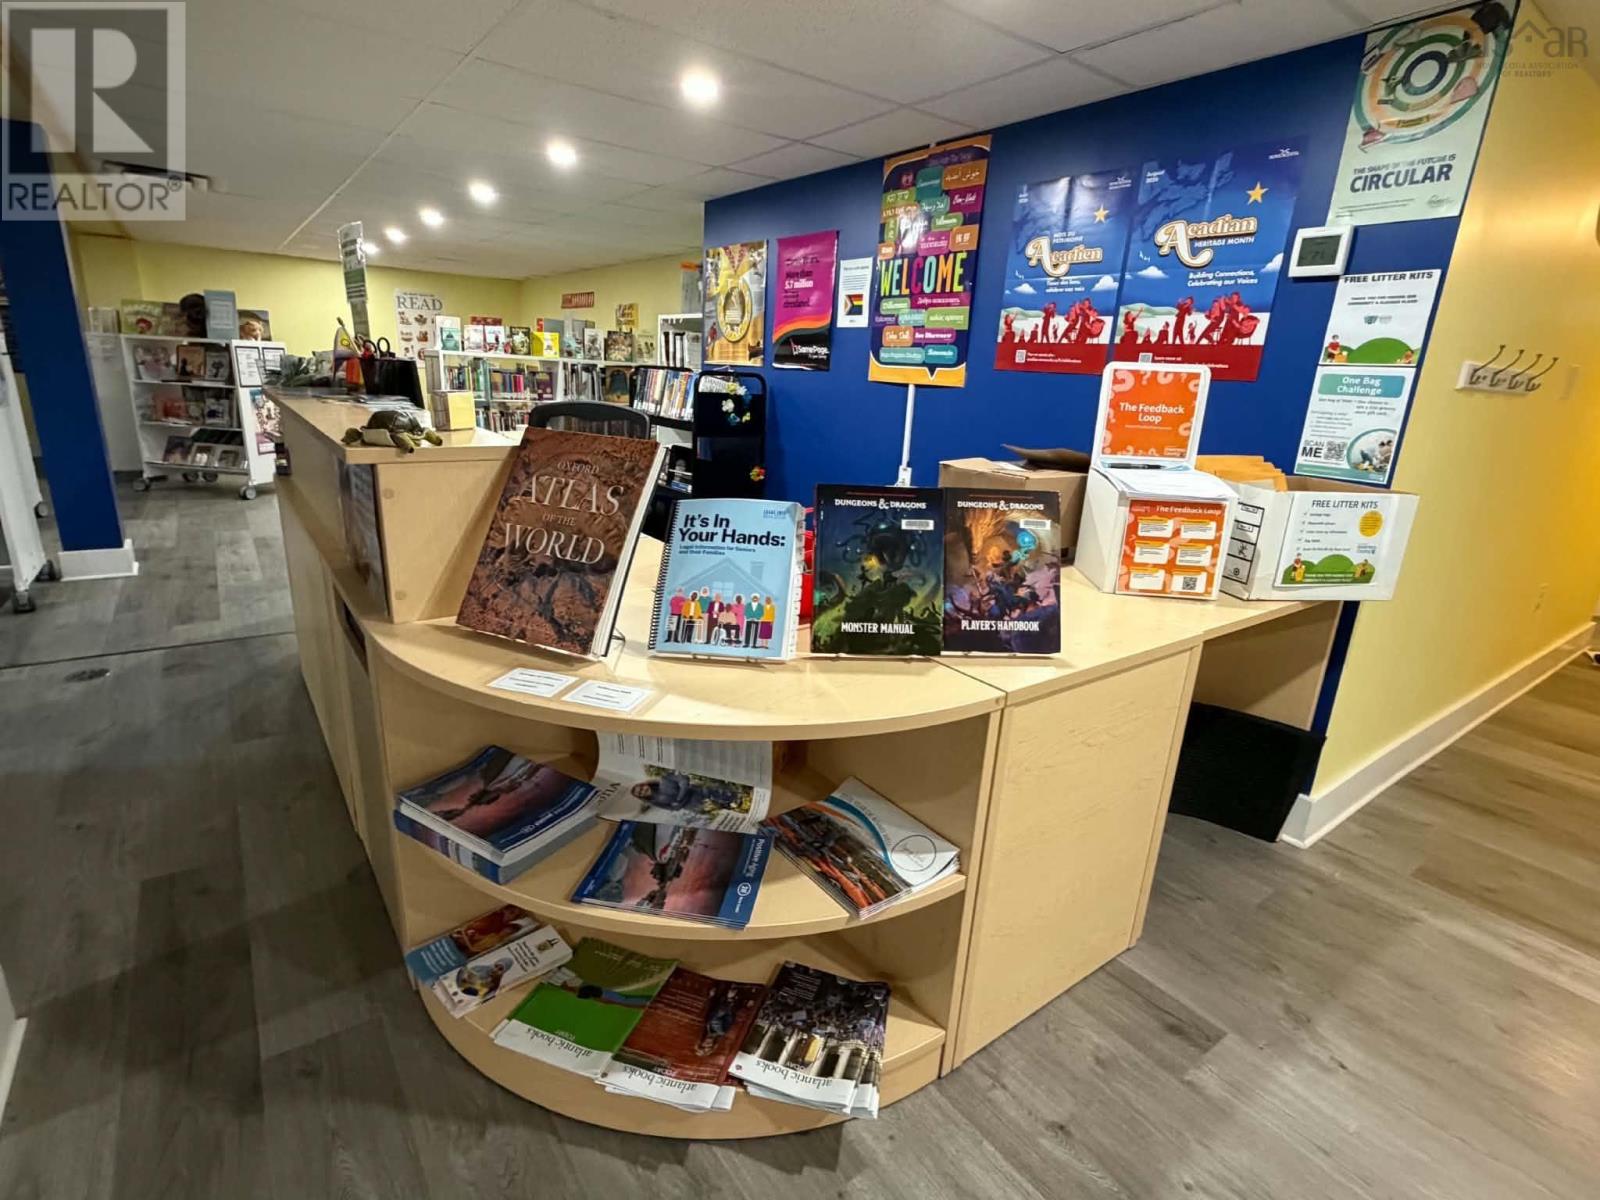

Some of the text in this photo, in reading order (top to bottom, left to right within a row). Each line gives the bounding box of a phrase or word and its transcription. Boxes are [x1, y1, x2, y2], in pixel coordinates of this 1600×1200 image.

[1448, 153, 1457, 161] IS
[1349, 163, 1453, 193] CIRCULAR
[1154, 213, 1258, 268] Acadian
[1194, 236, 1255, 248] HERITAGE MONTH
[1025, 236, 1103, 277] Acadien
[881, 252, 967, 296] WELCOME
[1189, 271, 1214, 280] Building
[1344, 271, 1433, 283] FREE LITTER KITS
[1187, 278, 1223, 287] Celebrating
[396, 295, 443, 311] READ
[1342, 376, 1381, 387] One Bag
[1336, 385, 1382, 396] Challenge
[1119, 402, 1185, 414] The Feedback
[1138, 413, 1162, 424] Loop
[1303, 439, 1325, 448] SCAN
[1301, 446, 1323, 459] ME
[557, 461, 600, 475] OXFORD
[508, 474, 625, 516] ATLAS
[834, 498, 927, 510] DUNGEONS & DRAGONS
[957, 500, 1045, 511] DUNGEONS & DRAGONS
[1156, 505, 1222, 516] The Feedback Loop
[1311, 499, 1379, 510] FREE LITTER KITS
[557, 514, 577, 527] THE
[713, 513, 730, 528] In
[503, 523, 605, 565] WORLD
[679, 528, 786, 547] Your Hands:
[841, 621, 915, 635] MONSTER MANUAL
[961, 619, 1040, 632] PLAYER'S HANDBOOK
[527, 1028, 593, 1059] atlantic books
[623, 1066, 697, 1094] atlantic books
[755, 1060, 832, 1089] atlantic books
